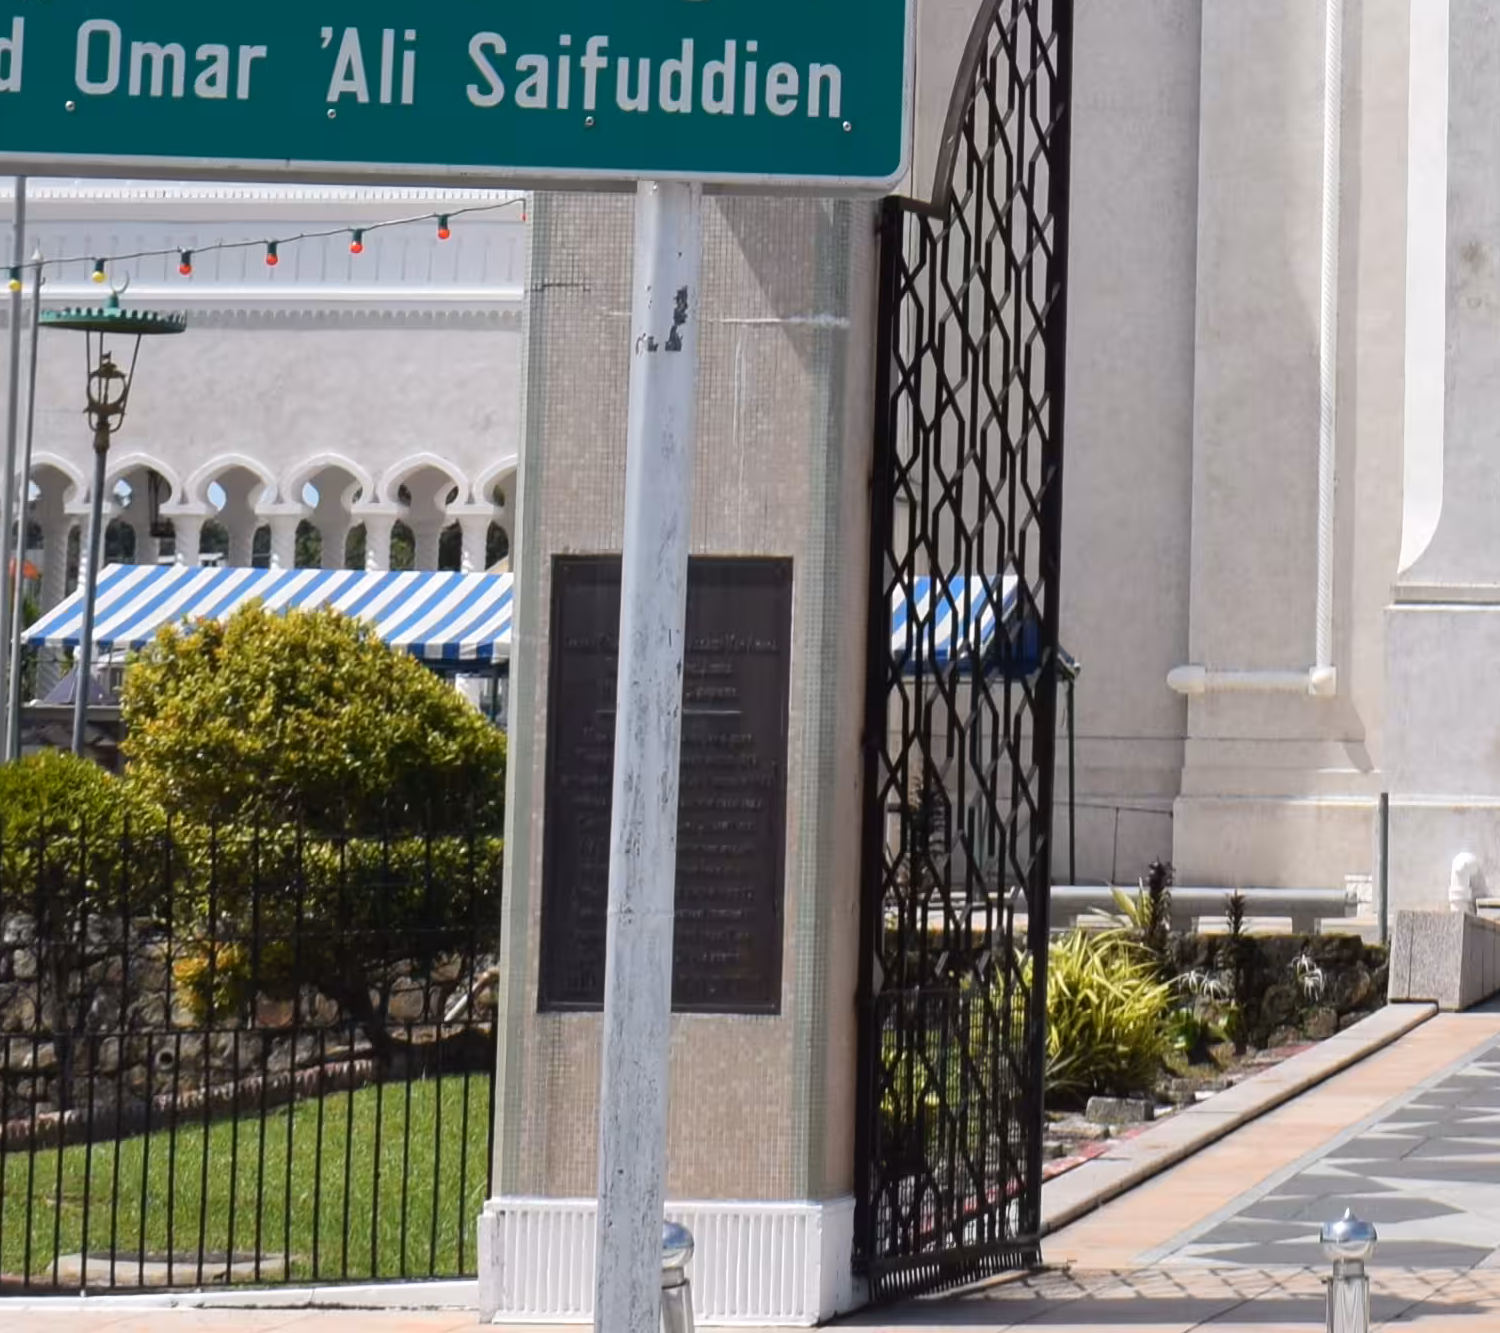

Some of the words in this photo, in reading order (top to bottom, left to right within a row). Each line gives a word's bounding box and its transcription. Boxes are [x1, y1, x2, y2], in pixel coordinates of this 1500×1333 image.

[74, 18, 268, 101] Omar
[320, 26, 417, 105] 'Ali
[466, 31, 842, 119] Saifuddien
